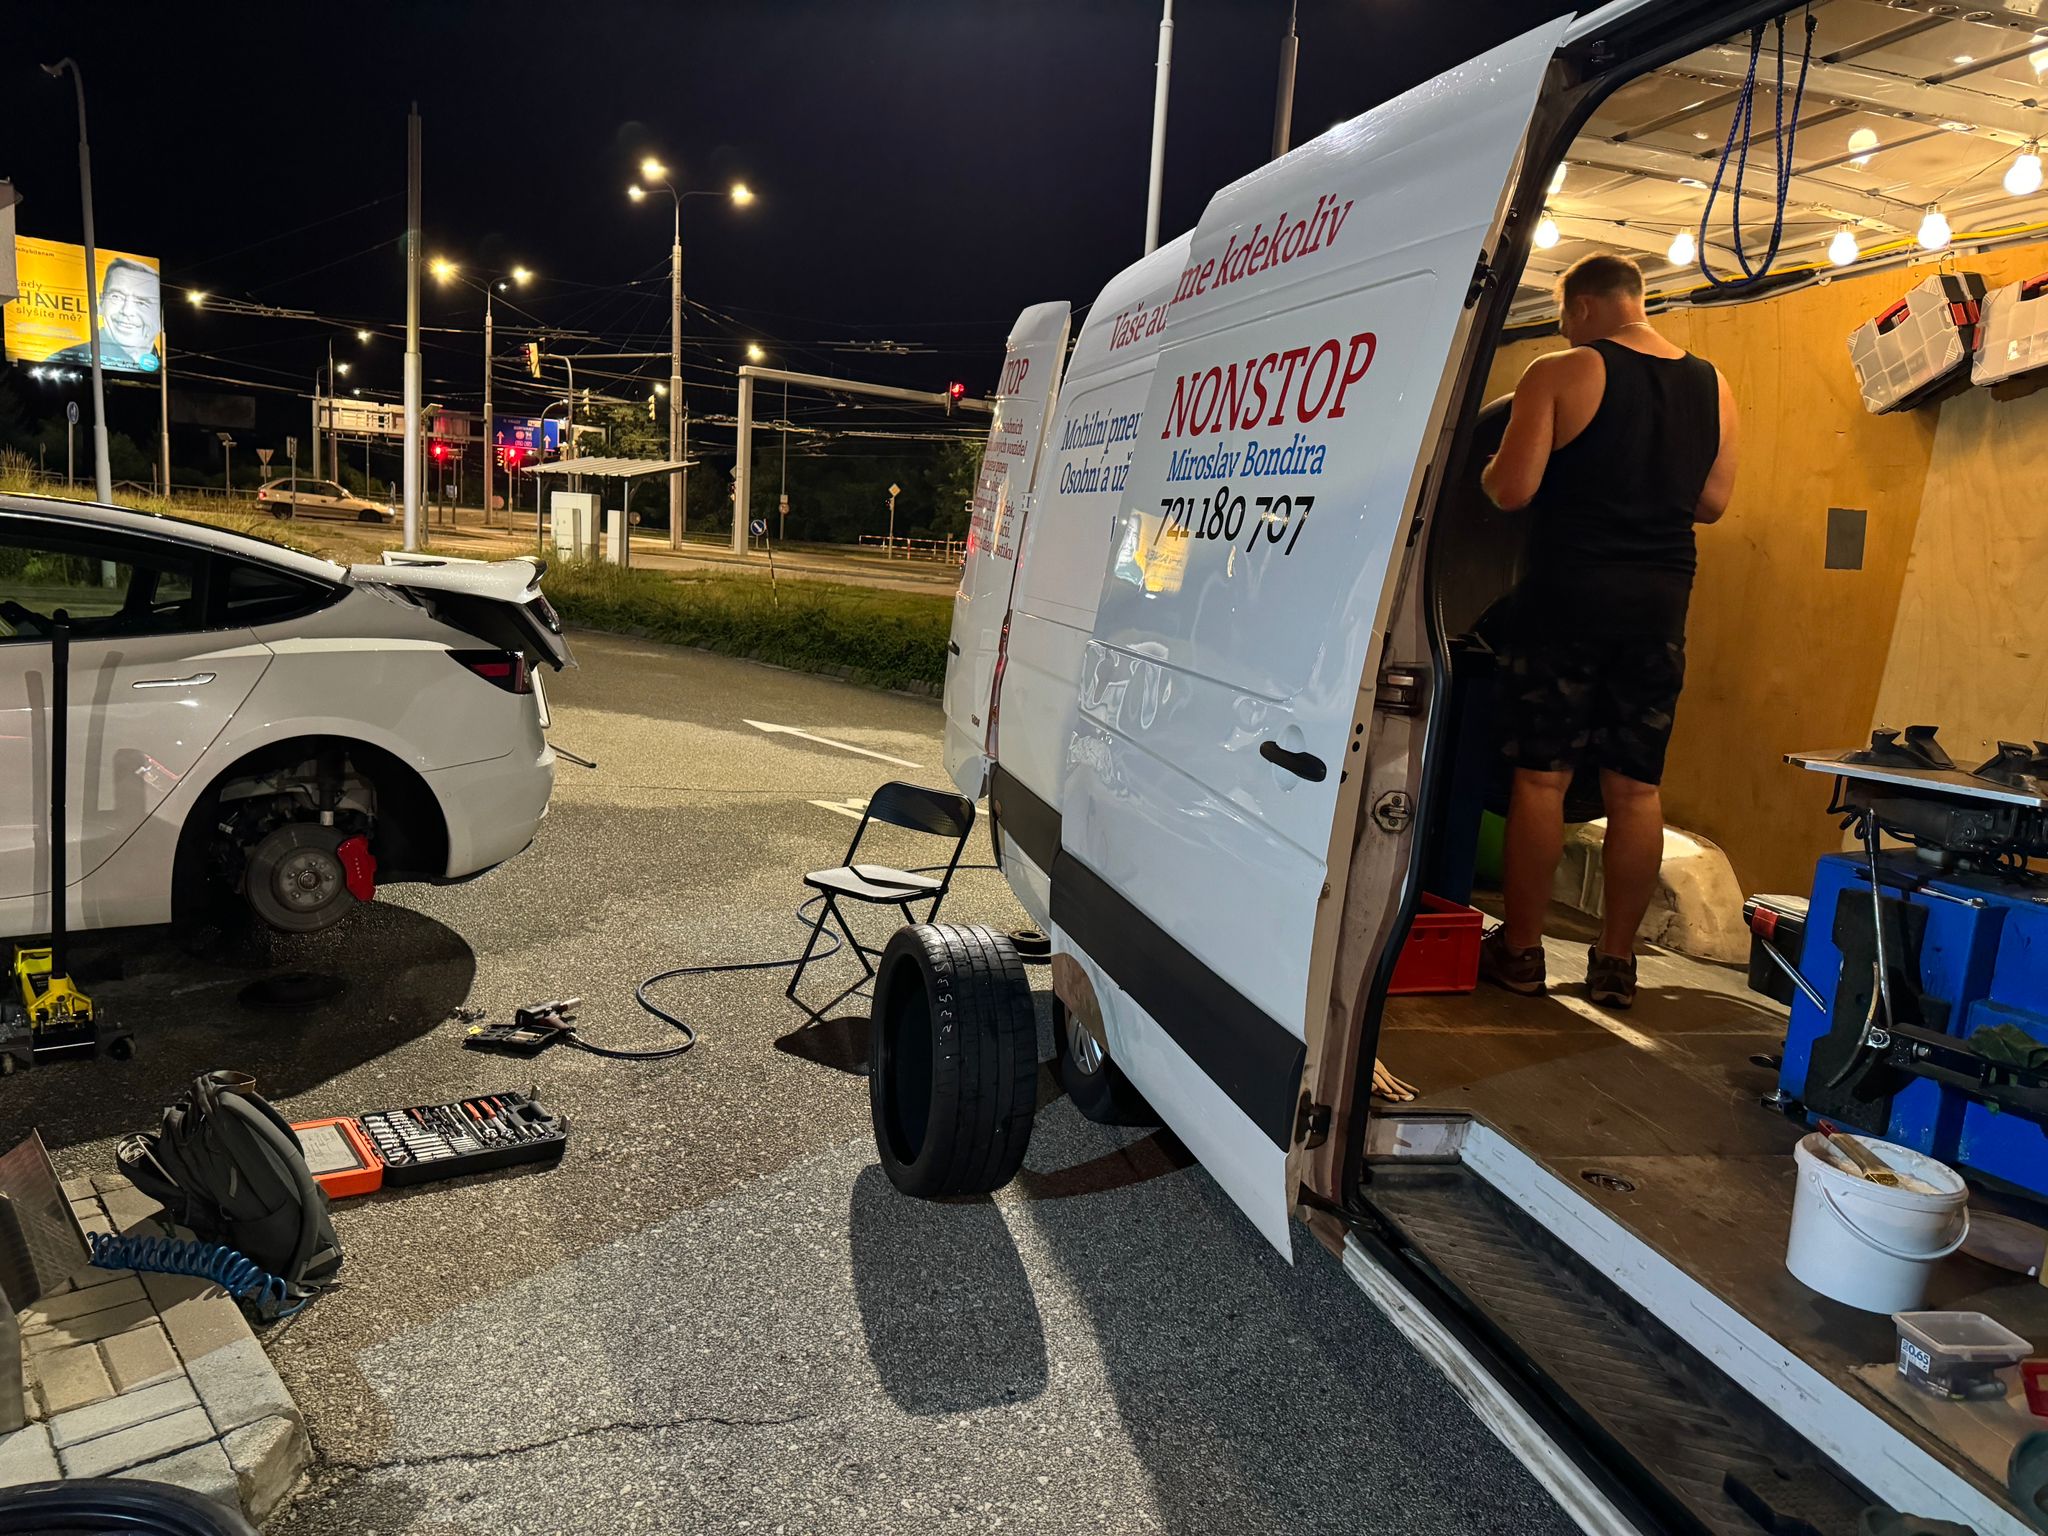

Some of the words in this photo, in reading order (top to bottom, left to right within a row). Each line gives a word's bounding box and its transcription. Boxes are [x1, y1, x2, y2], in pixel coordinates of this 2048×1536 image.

[1211, 193, 1354, 289] kdekoliv
[16, 280, 42, 292] ady
[16, 290, 87, 314] HAVEL
[1110, 301, 1147, 352] Vaše
[1161, 332, 1377, 440] NONSTOP
[1060, 408, 1112, 451] Mobilní
[1060, 457, 1104, 494] Osobní
[1100, 465, 1111, 492] a
[1166, 442, 1242, 482] Miroslav
[1239, 433, 1327, 477] Bondira
[1153, 497, 1195, 546] 721
[1195, 486, 1246, 541] 180
[1246, 495, 1315, 556] 707
[1908, 1344, 1929, 1366] 0.65
